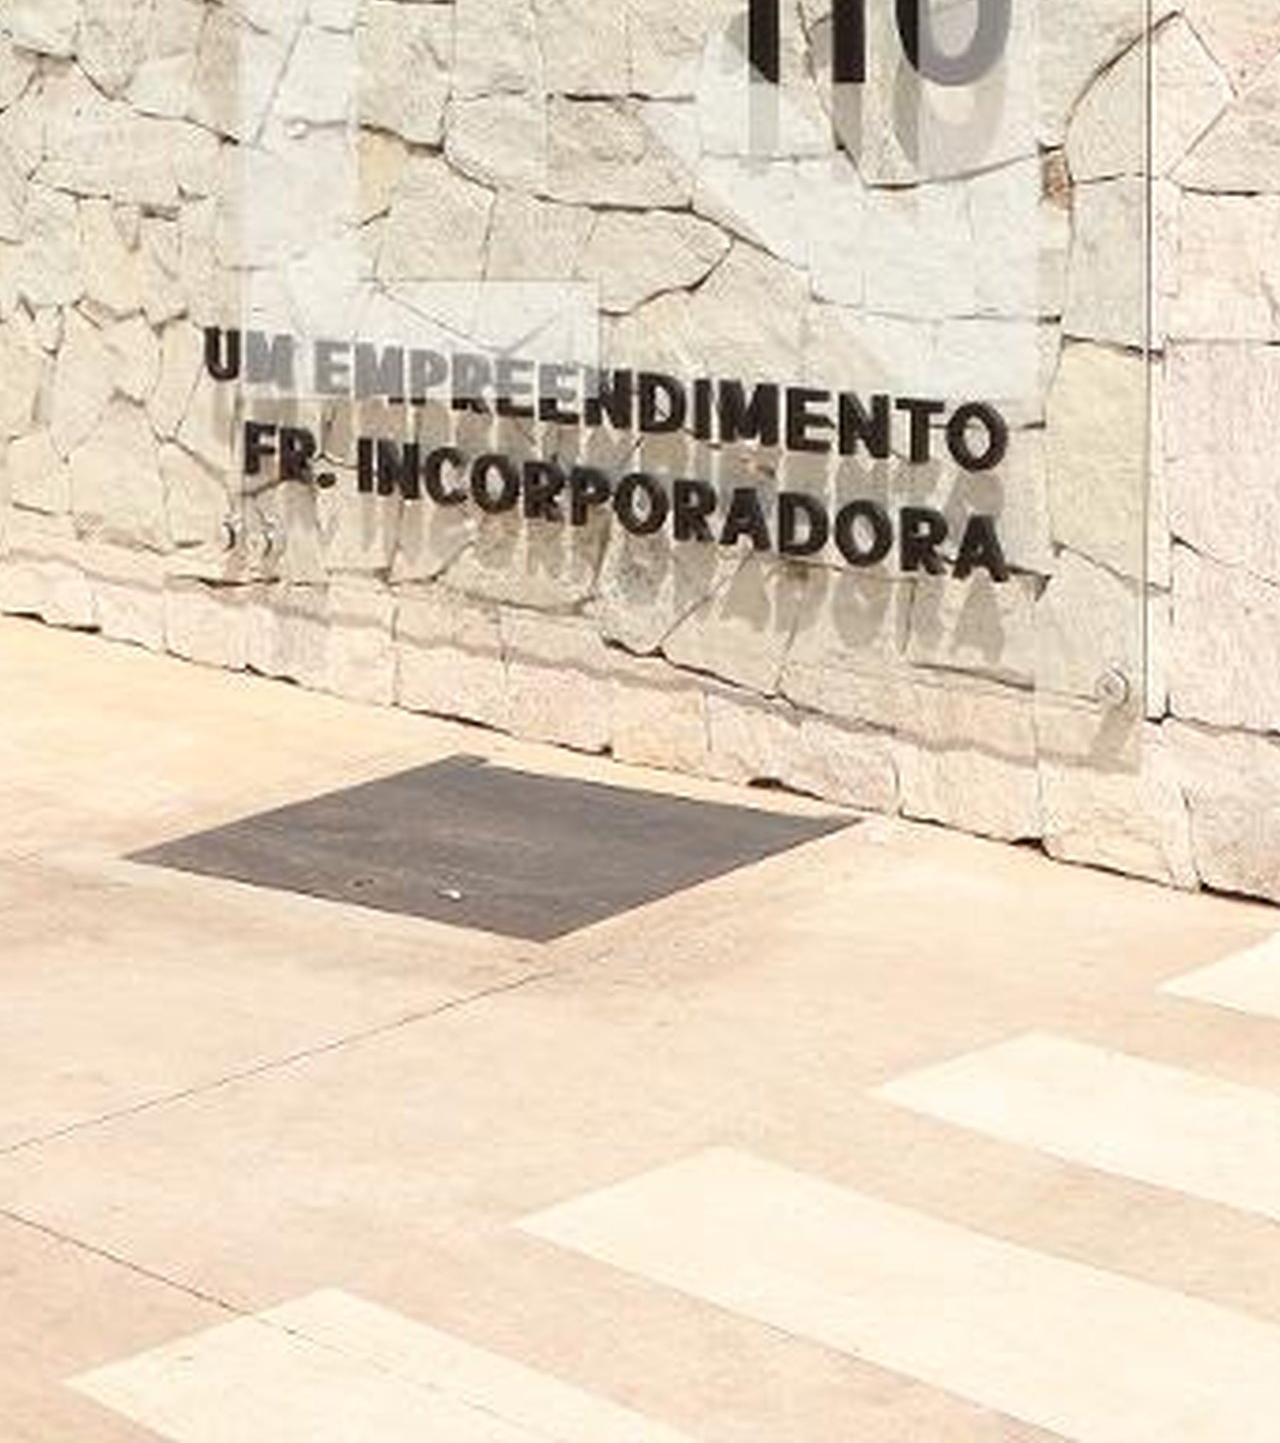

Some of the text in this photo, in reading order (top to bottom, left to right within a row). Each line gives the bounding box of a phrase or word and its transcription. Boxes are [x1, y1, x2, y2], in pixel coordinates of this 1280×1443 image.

[204, 325, 1010, 472] UM EMPREENDIMENTO
[243, 420, 1008, 582] FR. INCORPORADORA
